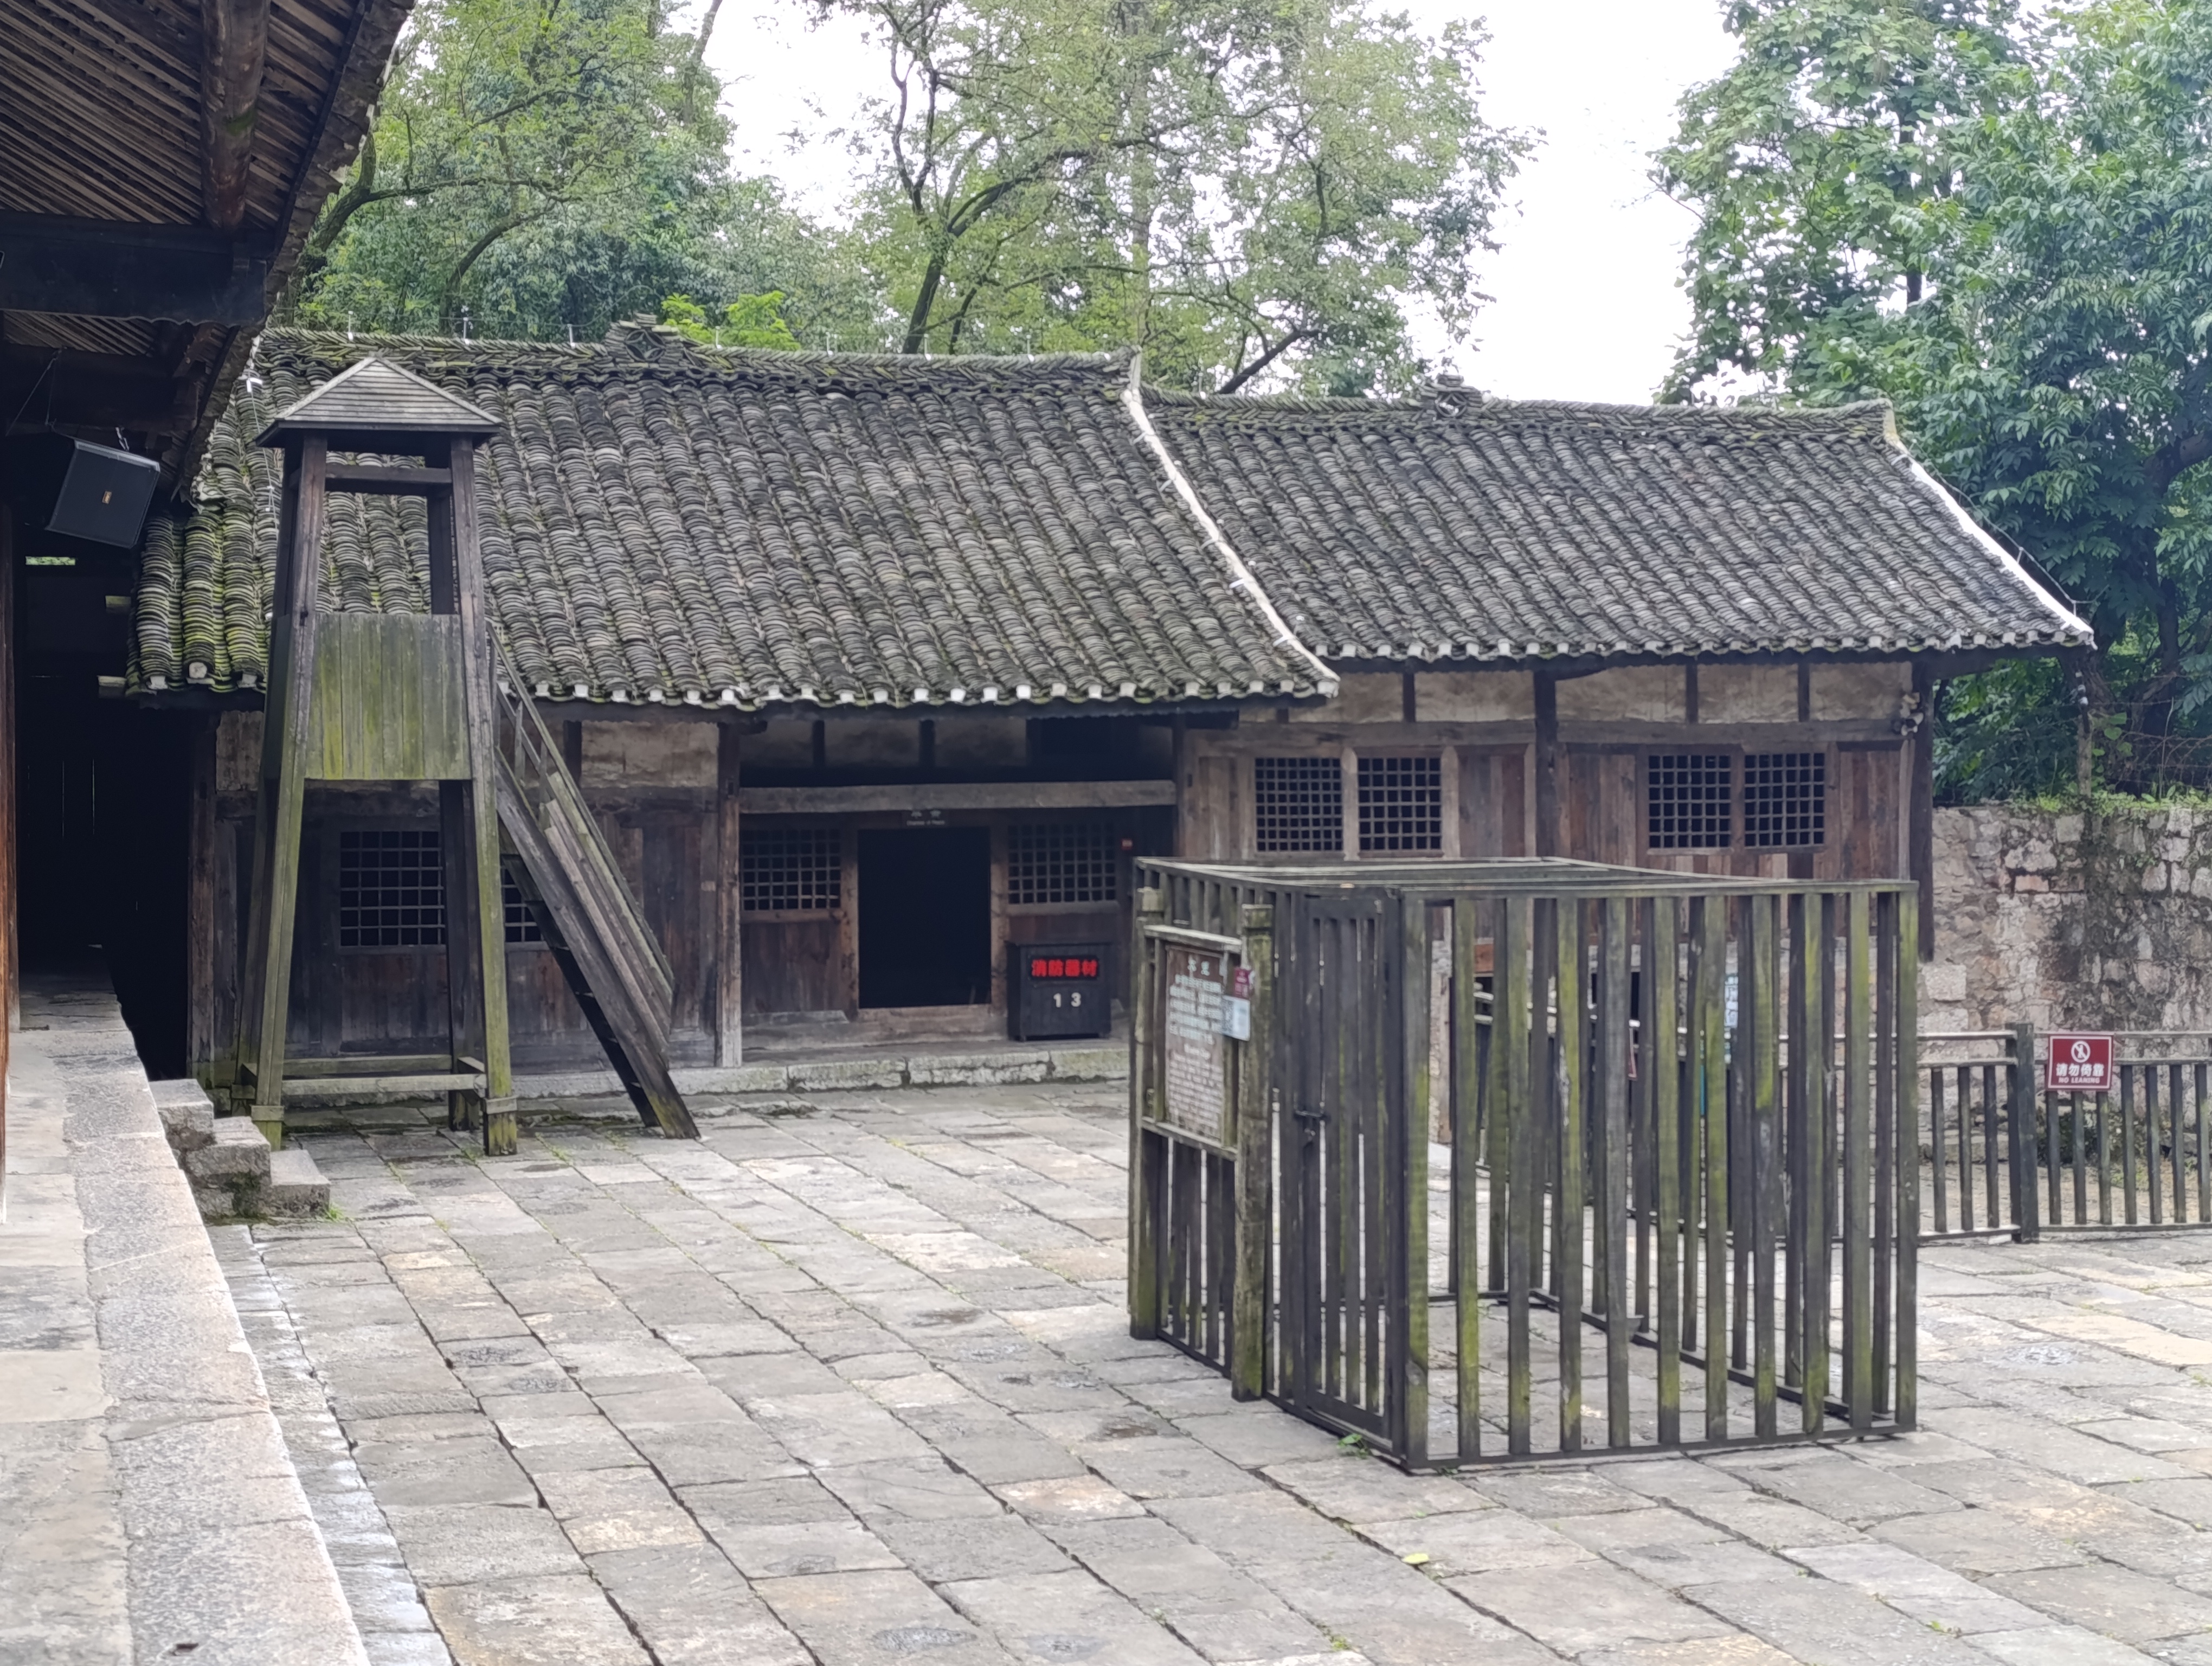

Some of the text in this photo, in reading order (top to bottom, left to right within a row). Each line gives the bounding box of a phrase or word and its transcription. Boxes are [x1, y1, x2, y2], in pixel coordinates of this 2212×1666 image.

[1032, 959, 1097, 977] 消防器材
[2056, 1063, 2104, 1077] 请勿倚靠
